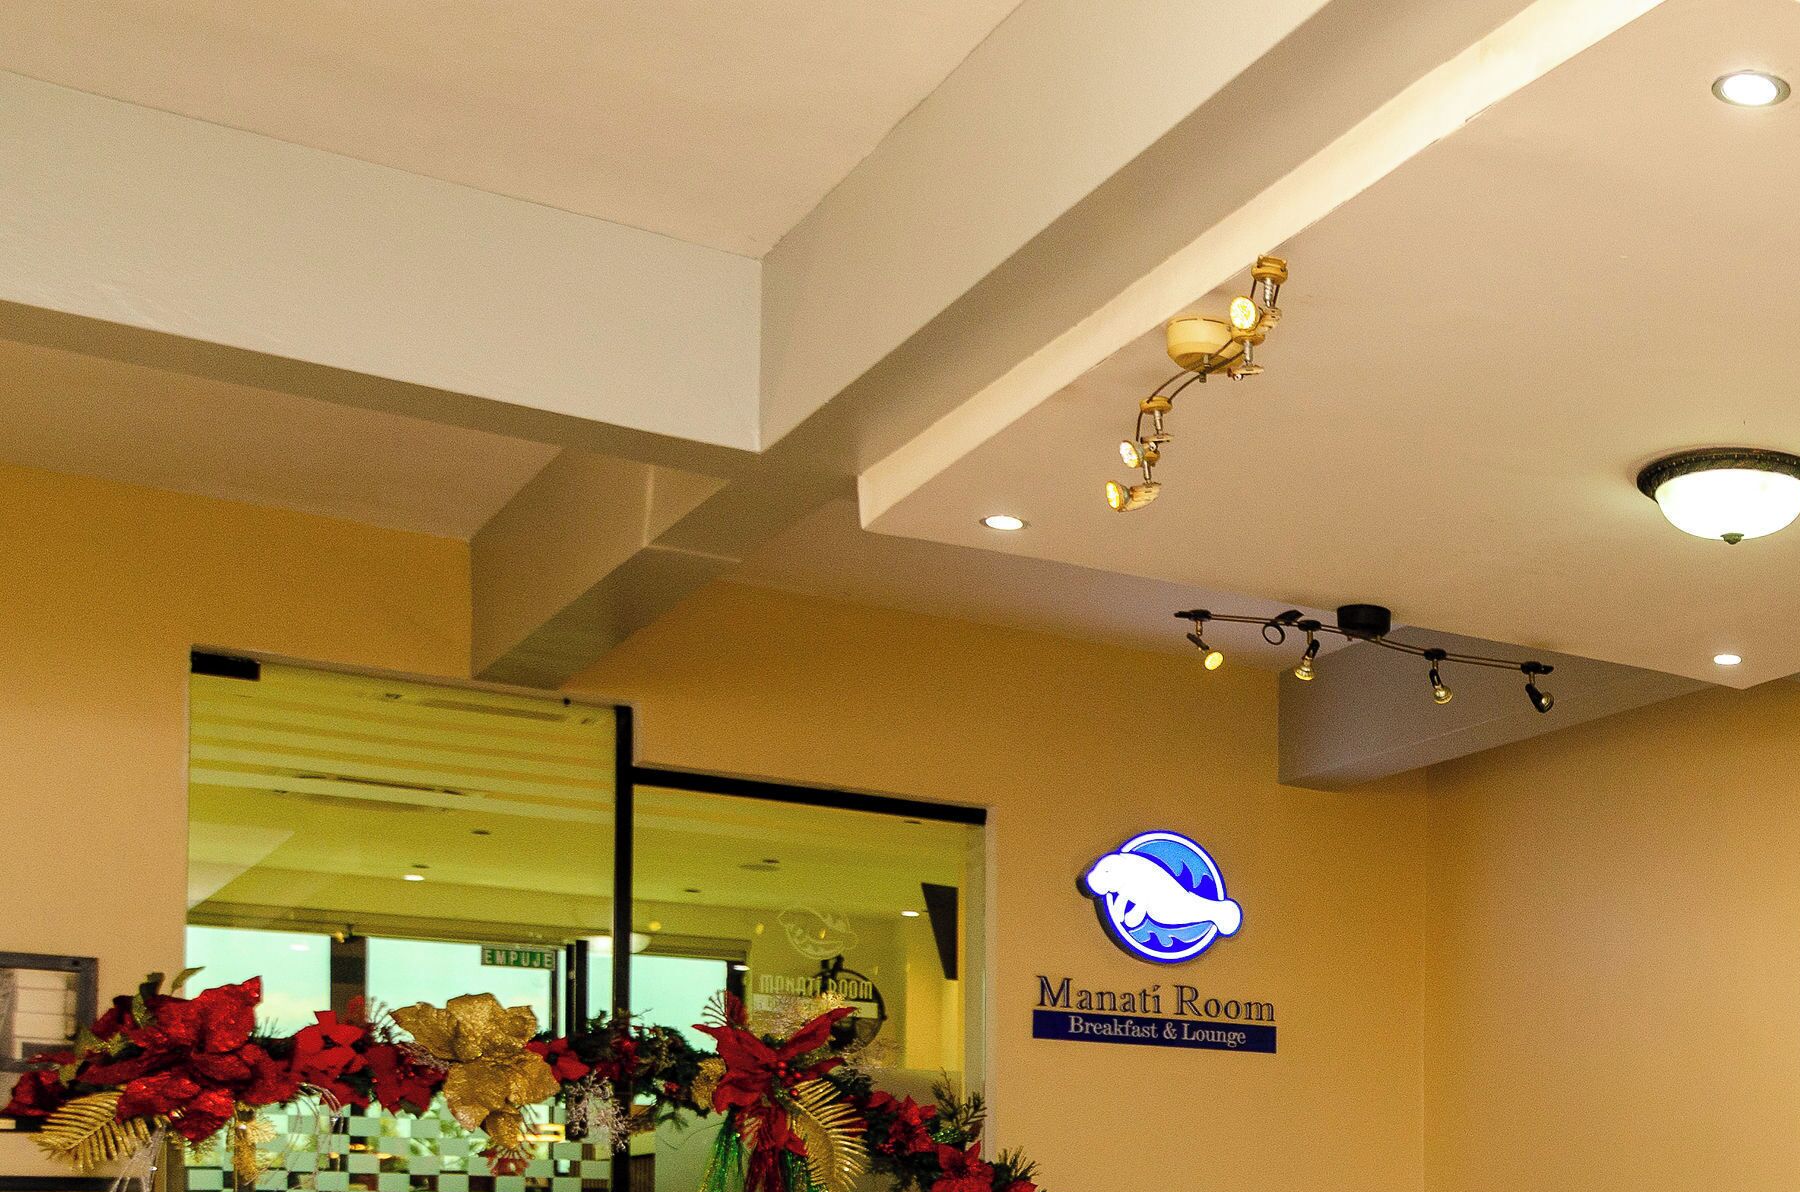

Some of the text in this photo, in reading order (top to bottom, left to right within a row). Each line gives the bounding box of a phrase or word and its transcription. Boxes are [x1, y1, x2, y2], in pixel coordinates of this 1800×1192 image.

[484, 949, 554, 968] EMPUJE
[1037, 974, 1276, 1022] Manatí Room
[1068, 1015, 1247, 1048] Breakfast & Lounge
